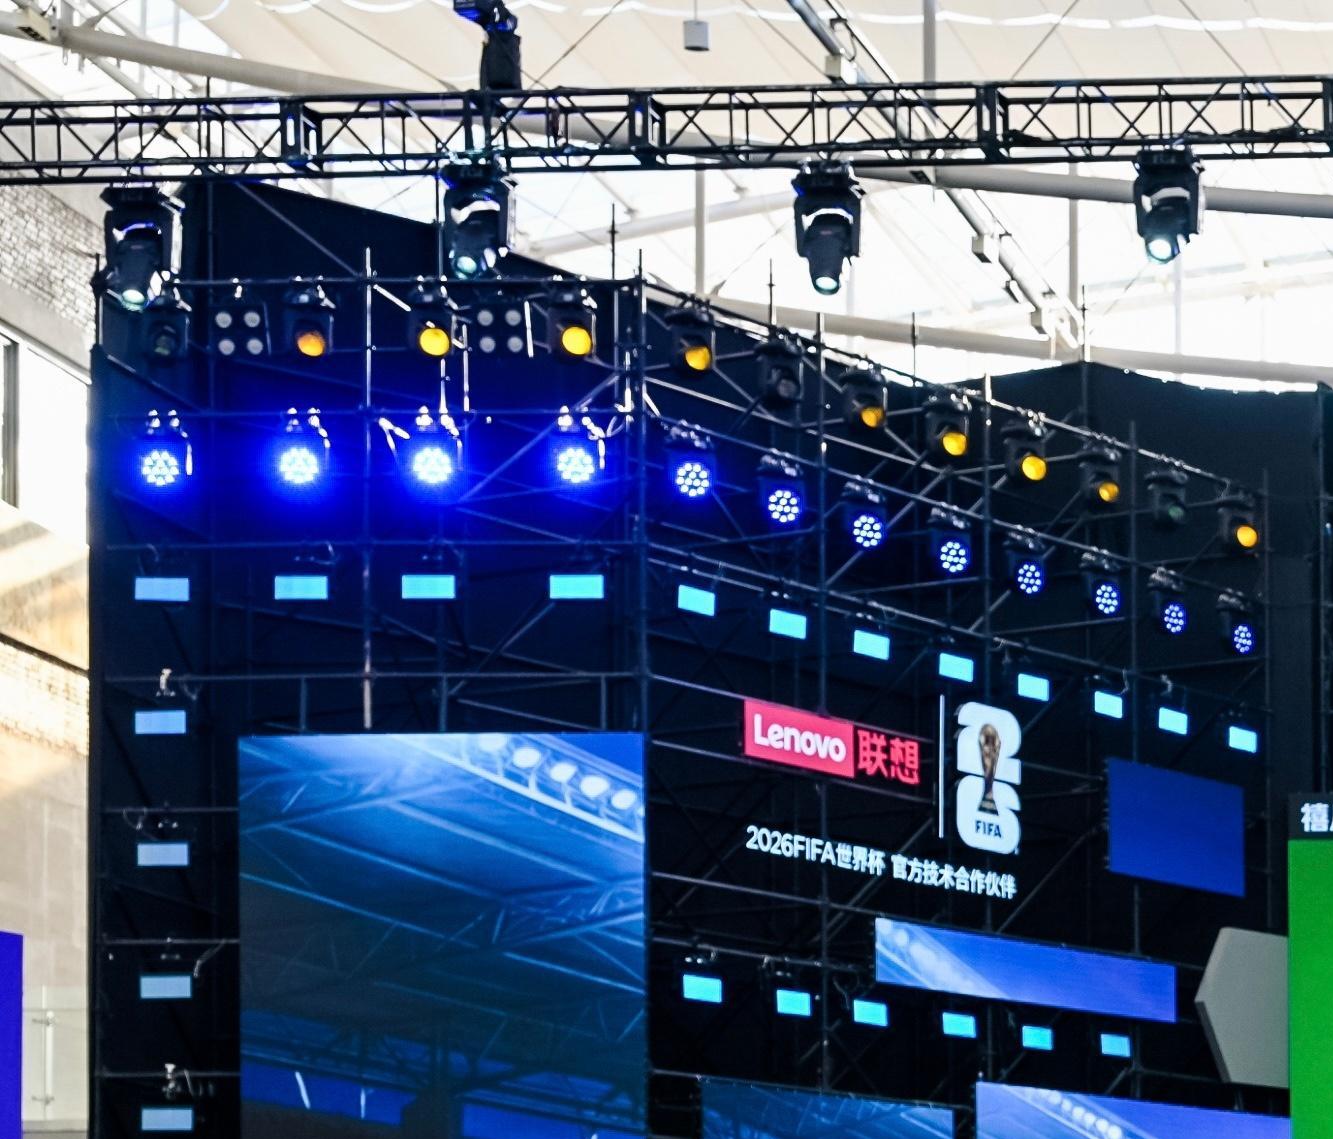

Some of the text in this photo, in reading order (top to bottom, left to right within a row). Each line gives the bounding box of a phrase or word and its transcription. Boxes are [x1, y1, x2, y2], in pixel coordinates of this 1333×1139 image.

[754, 714, 920, 785] Lenovo 联想
[746, 825, 1017, 899] 2026FIFA世界杯 官方技术合作伙伴
[975, 820, 1003, 838] FIFA
